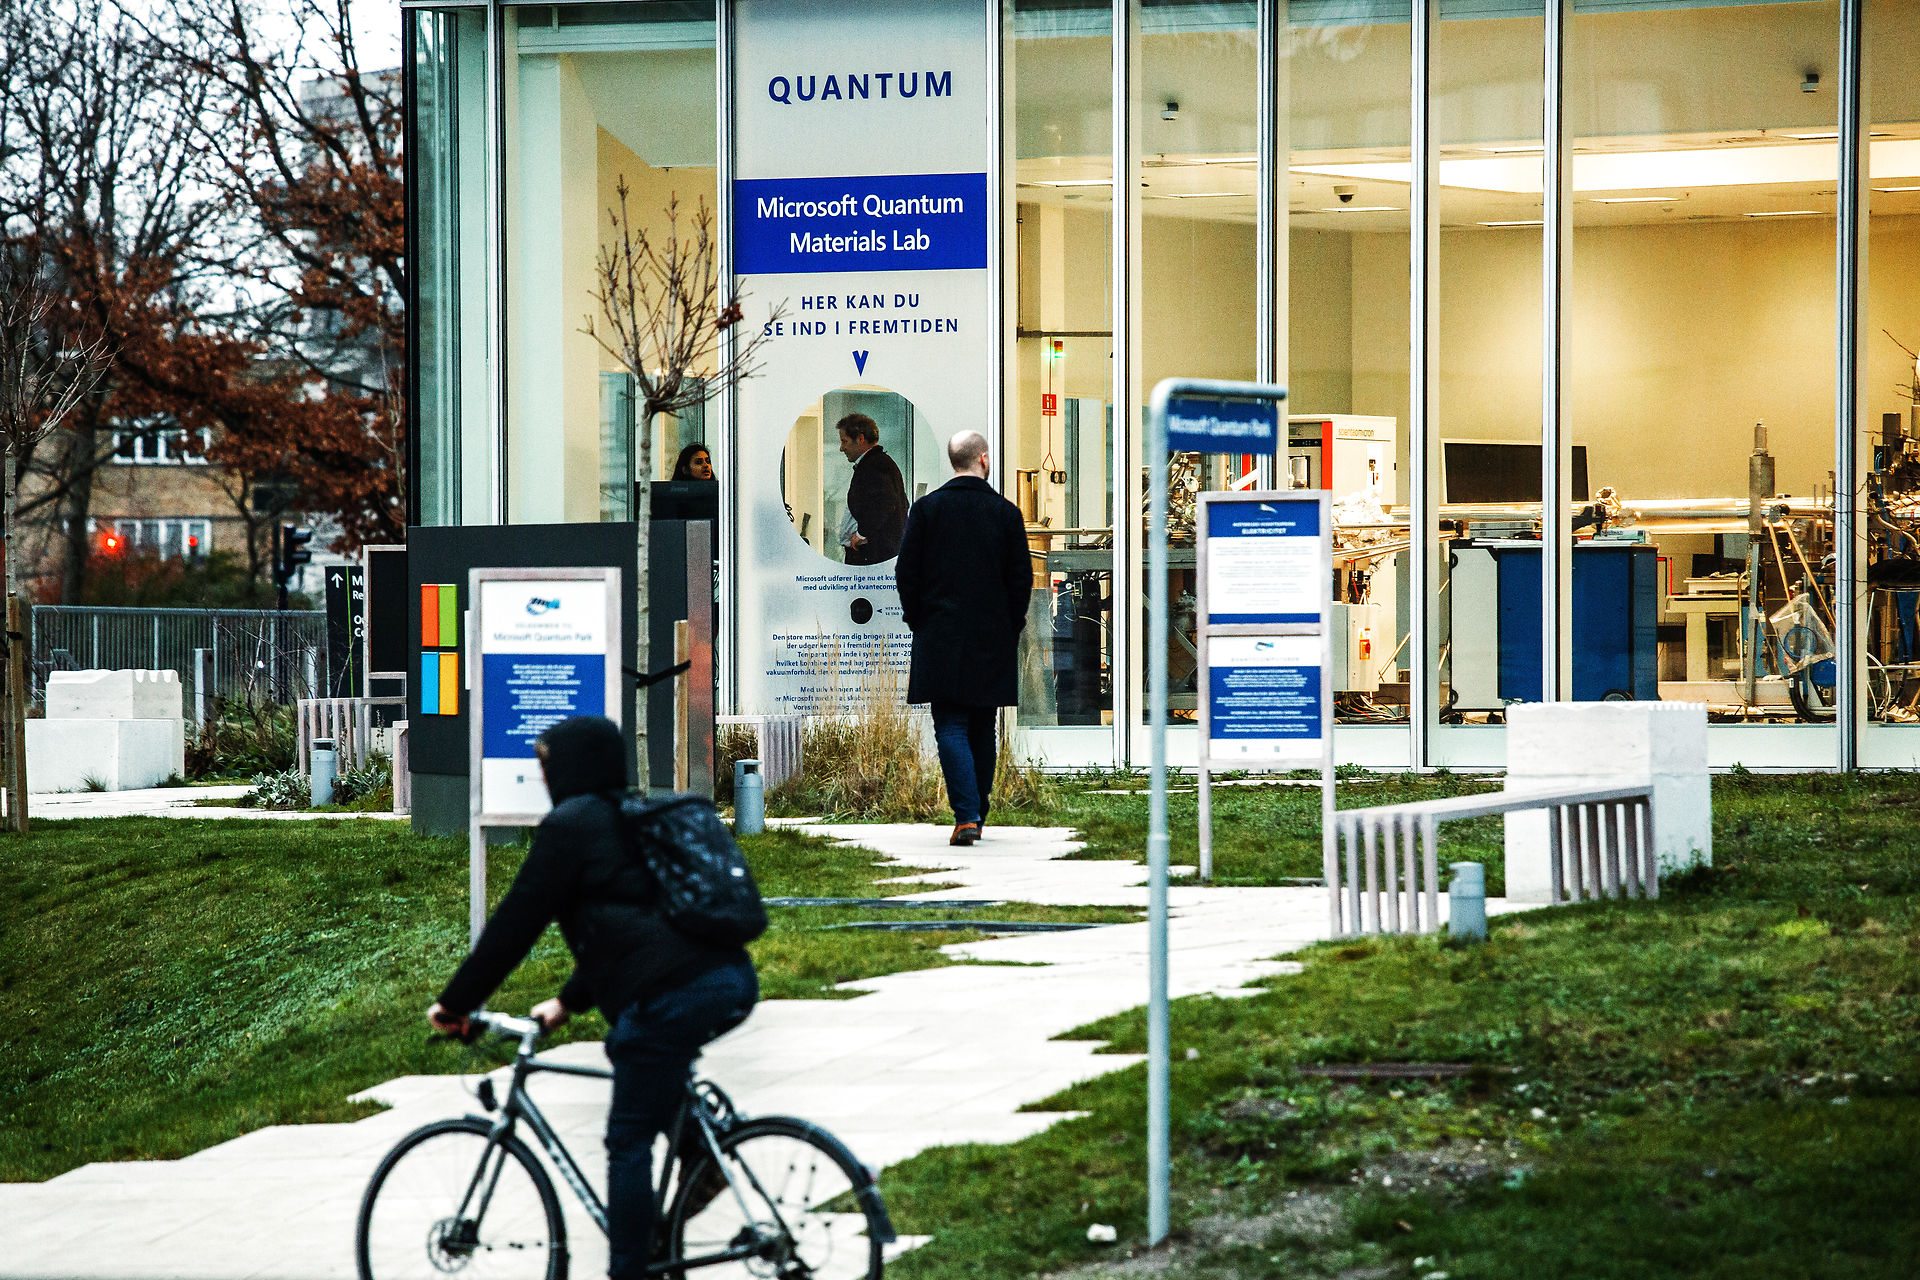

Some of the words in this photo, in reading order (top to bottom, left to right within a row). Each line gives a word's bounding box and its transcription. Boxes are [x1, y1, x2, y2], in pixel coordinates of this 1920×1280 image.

[768, 70, 952, 105] QUANTUM
[757, 193, 857, 218] Microsoft
[862, 194, 964, 218] Quantum
[790, 229, 887, 253] Materials
[892, 228, 930, 251] Lab
[801, 295, 837, 310] HER
[846, 294, 885, 309] KAN
[894, 293, 919, 308] DU
[763, 322, 784, 336] SE
[792, 321, 826, 335] IND
[835, 320, 840, 335] I
[848, 318, 958, 334] FREMTIDEN
[828, 574, 852, 582] udfører
[853, 574, 866, 583] lige
[818, 583, 848, 591] udvikling
[353, 614, 364, 624] O
[493, 632, 531, 641] Microsoft
[535, 632, 572, 642] Quantum
[574, 632, 592, 641] Park
[851, 633, 862, 641] dig
